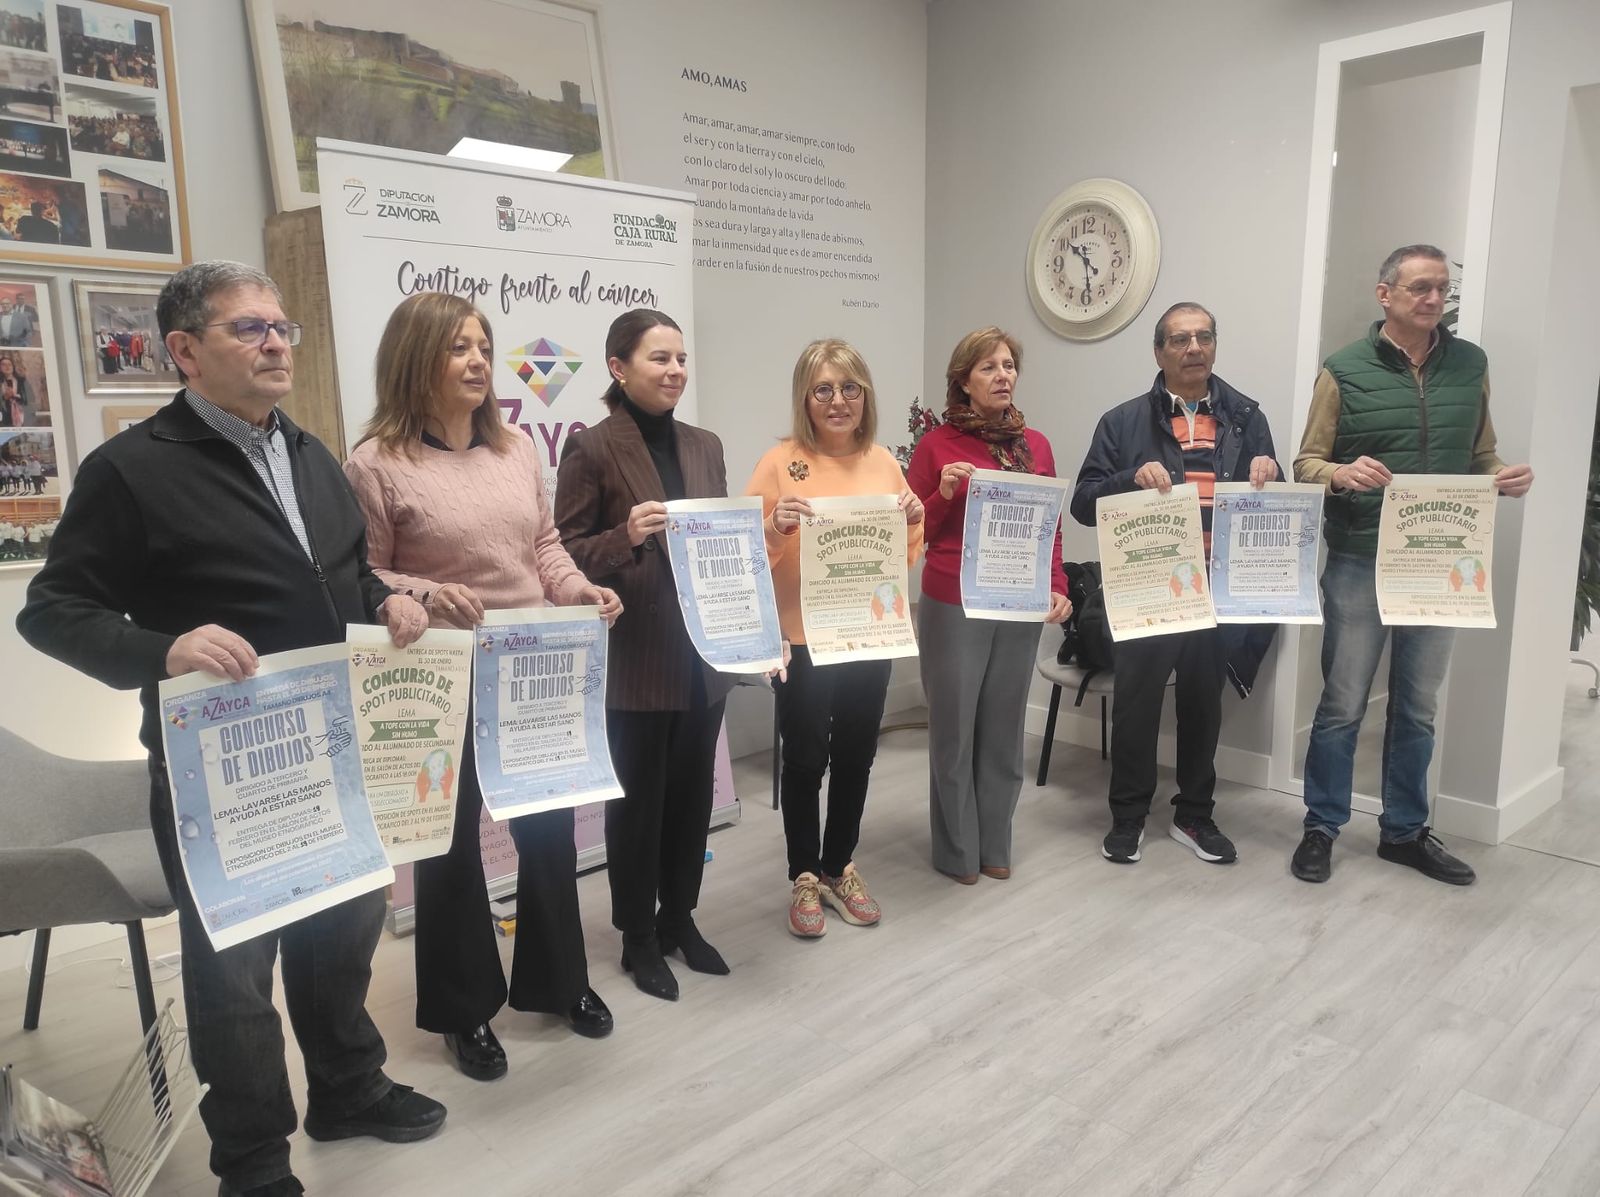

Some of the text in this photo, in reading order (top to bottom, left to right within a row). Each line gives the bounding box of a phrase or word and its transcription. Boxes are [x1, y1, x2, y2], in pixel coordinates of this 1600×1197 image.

[684, 132, 693, 143] el
[694, 136, 709, 146] ser
[709, 140, 717, 151] y
[718, 141, 735, 151] con
[737, 141, 744, 152] la
[746, 143, 769, 157] tierra
[771, 150, 777, 160] y
[778, 152, 793, 161] con
[795, 153, 802, 163] el
[762, 129, 784, 140] amar
[821, 141, 836, 150] con
[837, 142, 855, 154] todo
[684, 155, 826, 186] con lo claro del sol y lo oscuro del
[684, 175, 710, 188] Amar
[712, 180, 727, 191] por
[730, 181, 749, 193] toda
[750, 185, 781, 199] ciencia
[782, 191, 788, 201] y
[789, 192, 809, 202] amar
[811, 195, 825, 205] por
[826, 196, 844, 207] todo
[376, 204, 441, 224] ZAMORA
[516, 208, 572, 228] ZAMORA
[729, 200, 737, 211] la
[777, 207, 787, 218] de
[789, 209, 796, 219] la
[797, 211, 814, 221] vida
[614, 226, 678, 244] CAJA RURAL
[693, 218, 703, 227] os
[705, 219, 720, 229] sea
[722, 220, 742, 231] dura
[743, 224, 749, 235] y
[750, 222, 771, 237] larga
[772, 228, 777, 238] y
[779, 227, 793, 237] alta
[795, 230, 800, 240] y
[801, 229, 820, 241] llena
[821, 232, 830, 241] de
[1082, 216, 1096, 235] 12
[626, 240, 653, 248] ZAMORA
[1110, 231, 1117, 245] 2
[692, 237, 873, 264] mar la inmensidad que es de amor encendida
[1111, 250, 1123, 269] 3
[697, 257, 721, 268] arder
[723, 261, 734, 269] en
[736, 259, 744, 270] la
[745, 260, 770, 272] fusión
[772, 264, 782, 273] de
[784, 266, 818, 276] nuestros
[820, 268, 848, 278] pechos
[1053, 255, 1065, 274] 9
[397, 260, 658, 314] Contigo frente al cáncer
[1058, 276, 1066, 288] 8
[1098, 284, 1106, 297] 5
[1080, 288, 1092, 306] 6
[991, 504, 1035, 522] CONCURSO
[1398, 501, 1480, 520] CONCURSO DE
[987, 521, 1032, 539] DE DIBUJOS
[1113, 514, 1188, 537] CONCURSO DE
[1241, 515, 1291, 531] CONCURSO
[1396, 513, 1477, 533] SPOT PUBLICITARIO
[817, 525, 893, 546] CONCURSO DE
[1114, 526, 1188, 550] SPOT PUBLICITARIO
[1239, 531, 1291, 547] DE DIBUJOS
[696, 537, 741, 558] CONCURSO
[816, 538, 893, 562] SPOT PUBLICITARIO
[697, 557, 746, 579] DE DIBUJOS
[504, 632, 538, 650] AZAYCA
[513, 652, 574, 679] CONCURSO
[362, 667, 454, 695] CONCURSO DE
[511, 675, 574, 702] DE DIBUJOS
[202, 696, 251, 721] AZAYCA
[359, 687, 452, 717] SPOT PUBLICITARIO
[398, 708, 416, 718] LEMA
[219, 707, 308, 755] CONCURSO
[385, 722, 398, 730] TOPE
[418, 720, 430, 728] VIDA
[391, 731, 401, 739] SIN
[537, 721, 557, 729] ESTAR
[423, 739, 455, 748] SECUNDARIA
[221, 736, 315, 786] DE DIBUJOS
[235, 770, 303, 794] DIRIGIDO TERCERO
[237, 775, 309, 799] CUARTO DE PRIMARIA
[214, 788, 299, 820] LEMA: LAVARSE LAS
[229, 790, 322, 824] AYUDA A ESTAR SANO
[228, 820, 297, 847] FEBRERO EN SALON
[236, 819, 277, 837] ENTREGA DE
[239, 817, 324, 850] DEL MUSEO ETNOGRAFICO
[266, 822, 342, 854] DE DIBUJOS MUSEO
[316, 828, 345, 842] FEBRERO
[226, 843, 300, 873] ETNOGRAFICO DEL AL
